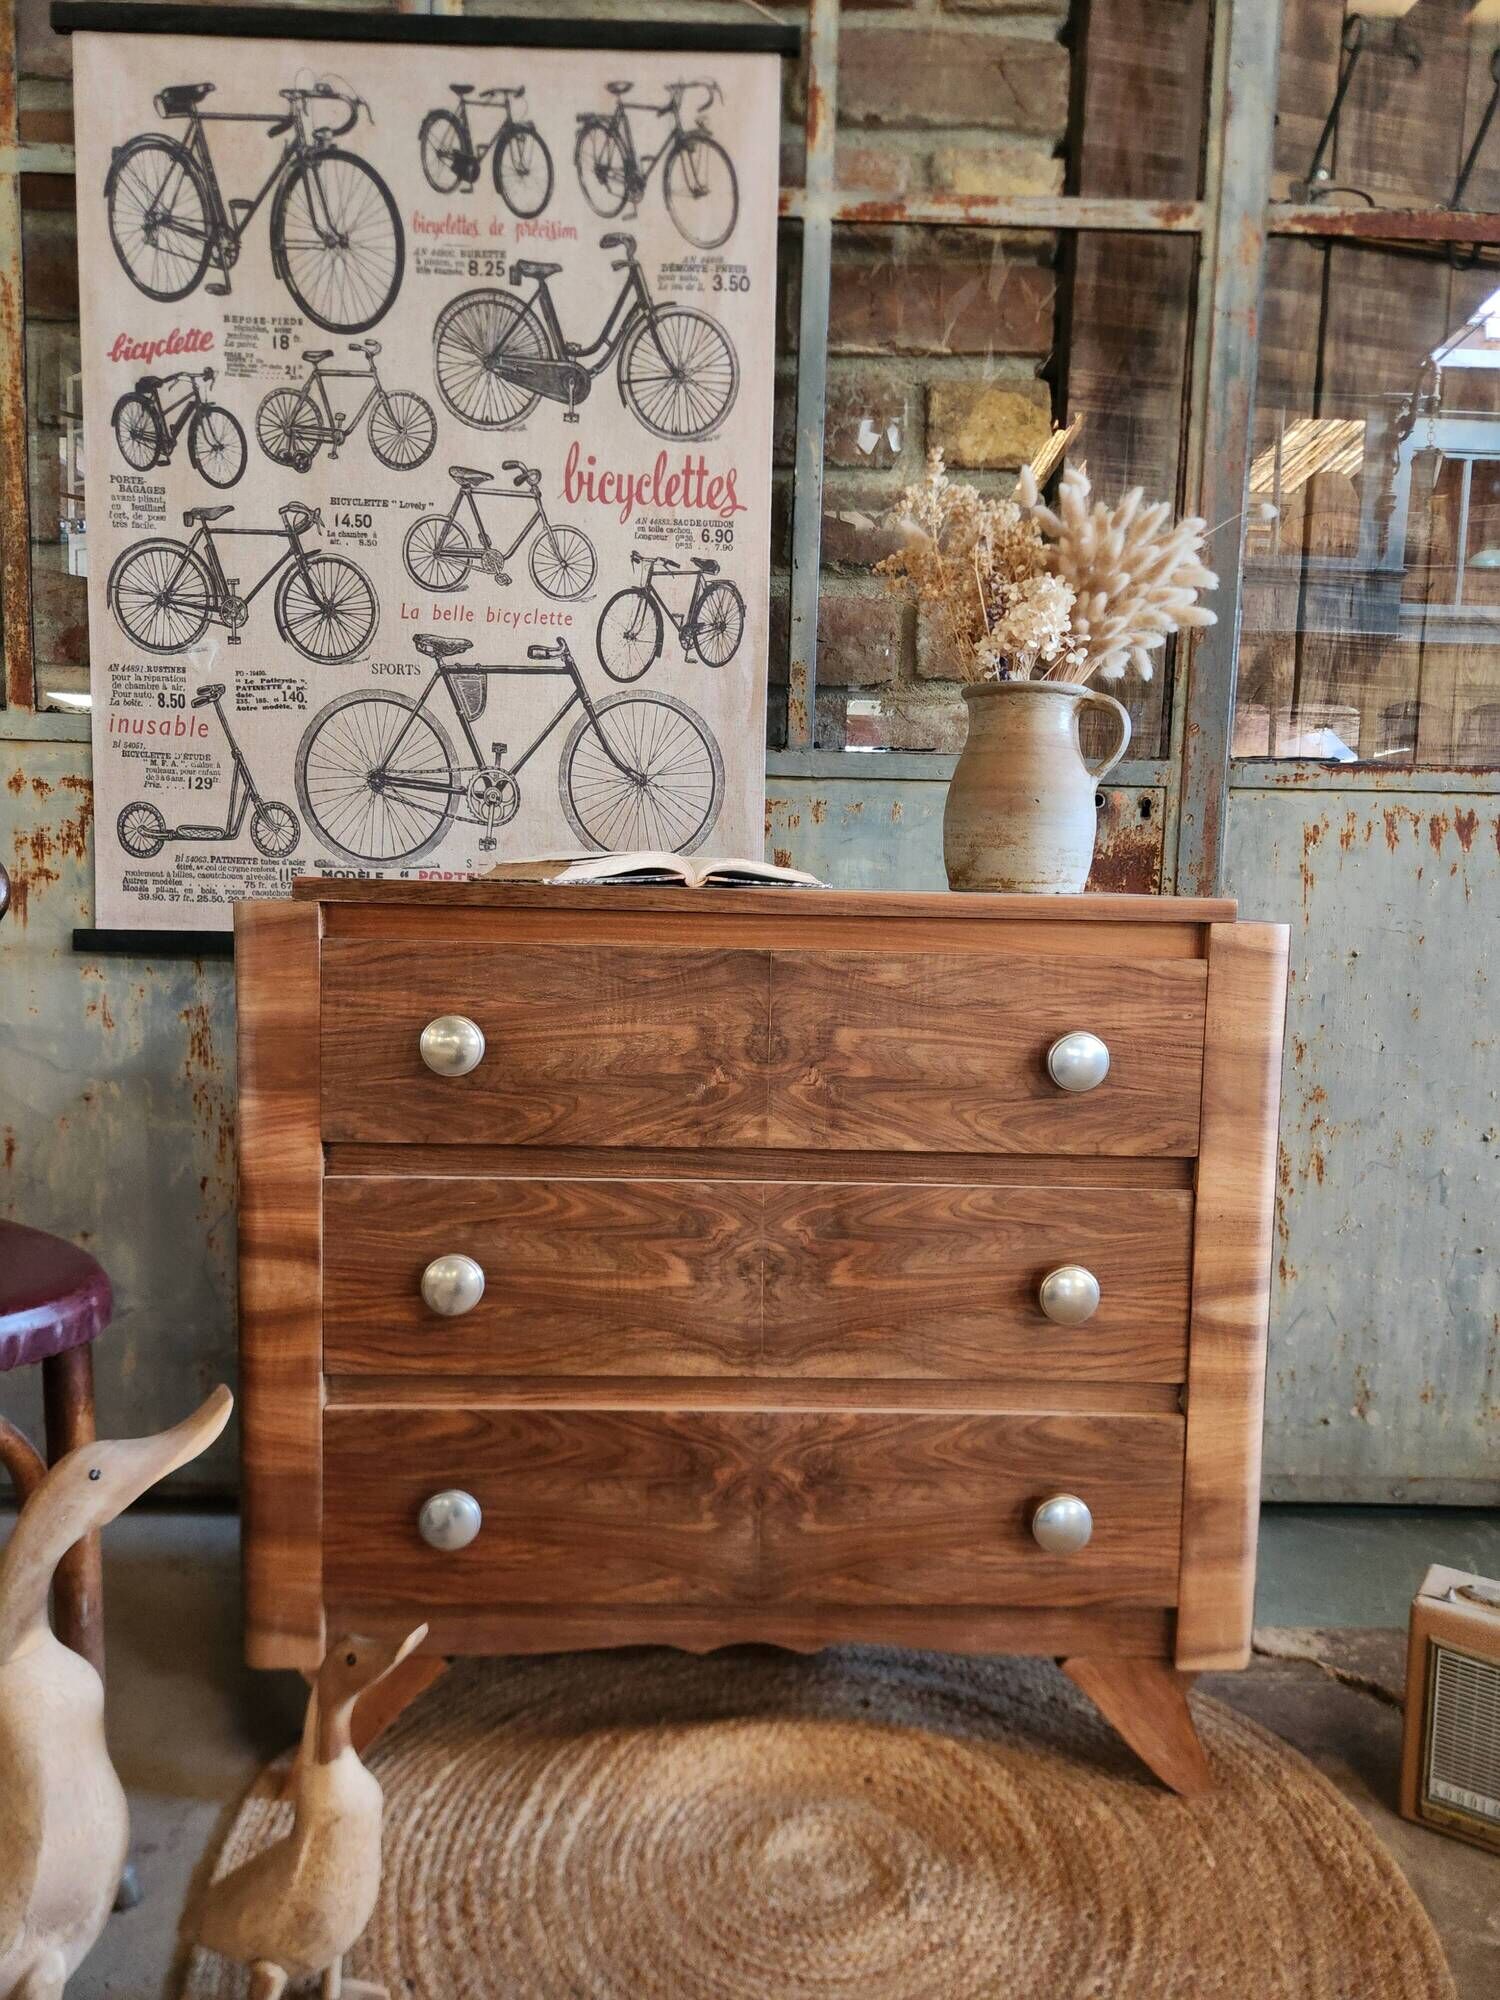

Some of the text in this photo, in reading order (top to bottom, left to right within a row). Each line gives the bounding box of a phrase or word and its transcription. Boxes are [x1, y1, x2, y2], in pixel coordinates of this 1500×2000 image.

[411, 210, 479, 240] bicyclettes
[489, 214, 504, 237] de
[469, 259, 505, 277] 8.25
[712, 273, 751, 292] 3.50
[106, 327, 214, 364] bicyclette
[272, 334, 289, 350] 18
[119, 484, 166, 495] BAGAGES
[560, 441, 748, 525] bicyclettes
[329, 496, 390, 508] BICYCLETTE
[334, 512, 373, 529] 14.50
[701, 528, 734, 544] 6.90
[400, 603, 573, 629] La belle bicyclette
[371, 663, 421, 676] SPORTS
[111, 674, 131, 684] pour
[111, 682, 122, 690] de
[124, 682, 160, 691] chambre
[235, 684, 283, 692] PATINETTE
[157, 692, 187, 709] 8.50
[281, 690, 308, 704] 140.
[109, 713, 209, 738] inusable
[121, 749, 172, 761] BICYCLETTE
[188, 776, 213, 790] 129
[210, 855, 258, 865] PATINETTE
[417, 871, 481, 881] PORTE
